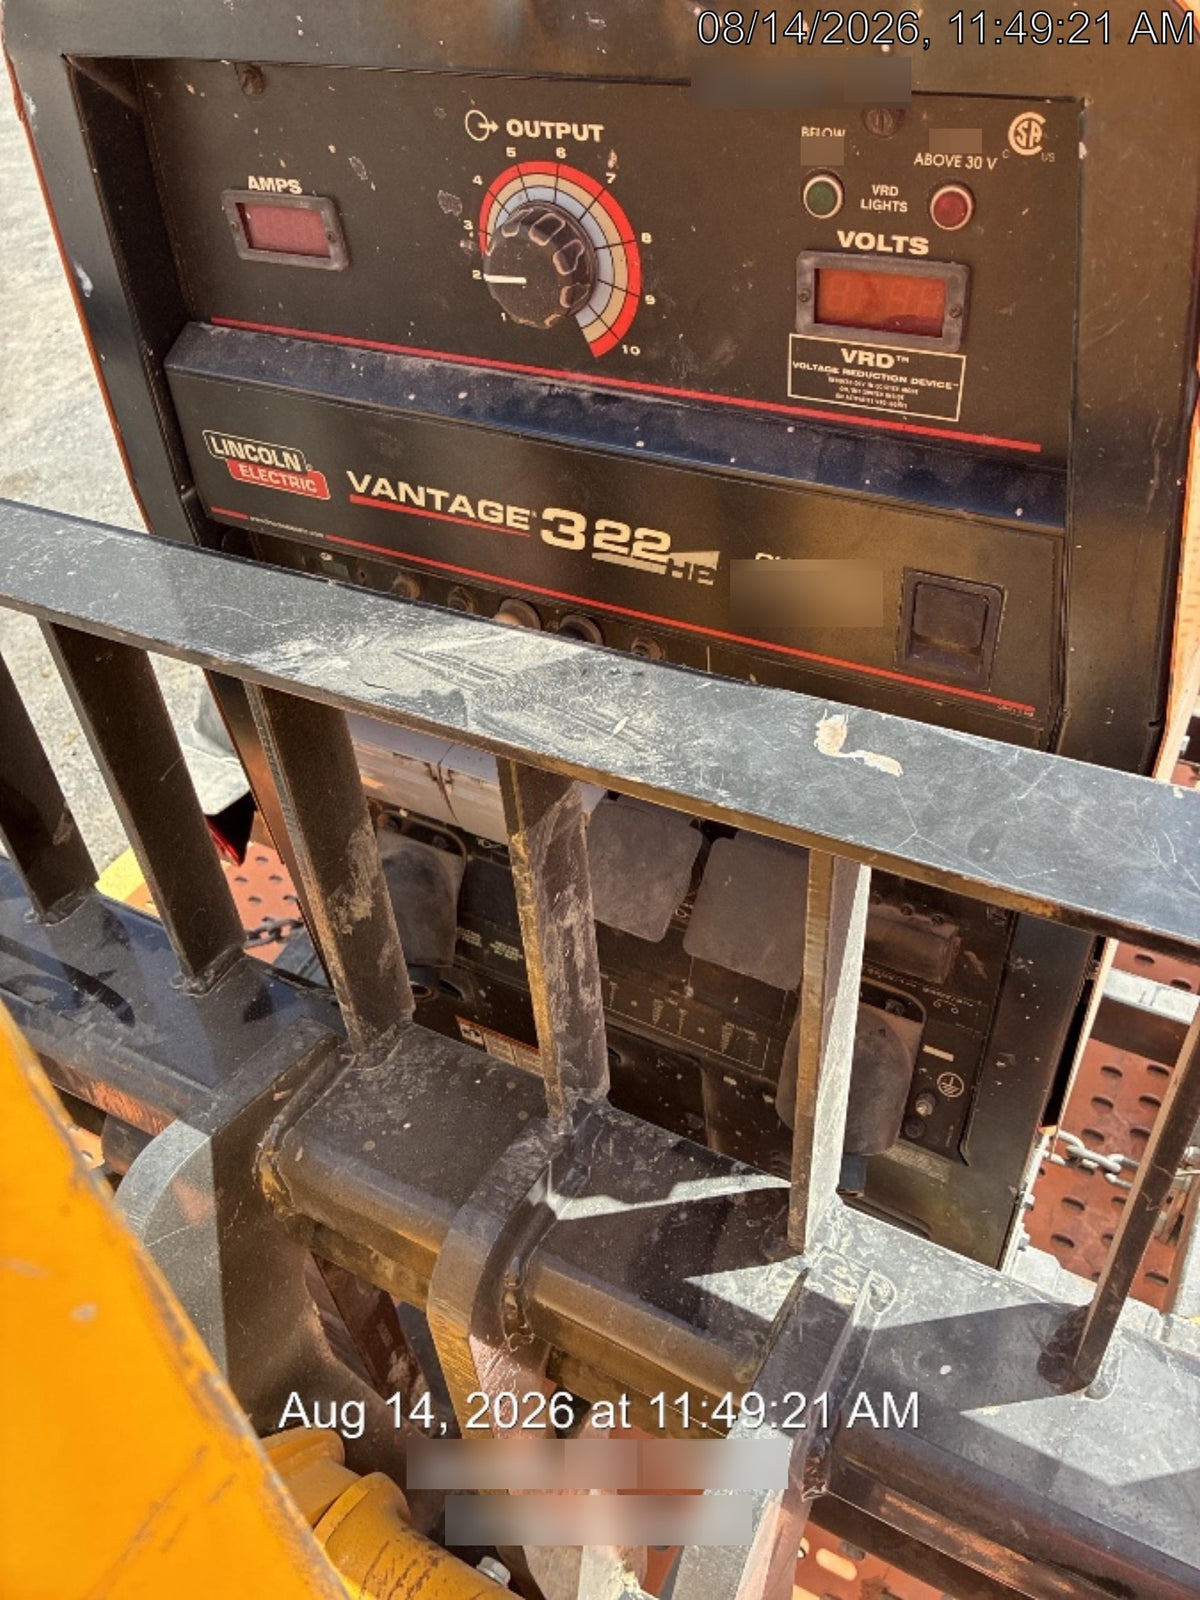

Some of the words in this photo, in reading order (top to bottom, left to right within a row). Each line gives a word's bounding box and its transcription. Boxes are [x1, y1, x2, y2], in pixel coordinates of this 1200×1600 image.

[506, 119, 605, 142] OUTPUT
[506, 147, 516, 158] 5
[555, 147, 566, 159] 6
[913, 153, 962, 168] ABOVE
[965, 154, 983, 169] 30
[986, 157, 998, 170] V
[472, 175, 483, 186] 4
[605, 172, 617, 183] 7
[248, 175, 303, 195] AMPS
[872, 184, 898, 196] VRD
[860, 199, 908, 212] LIGHTS
[463, 220, 473, 230] 3
[641, 232, 652, 243] 8
[837, 230, 930, 255] VOLTS
[472, 270, 482, 280] 2
[645, 294, 656, 305] 9
[500, 312, 507, 321] 1
[622, 344, 641, 355] 10
[209, 435, 303, 472] LINCOLN
[237, 463, 318, 494] ELECTRIC
[346, 470, 530, 531] VANTAGE
